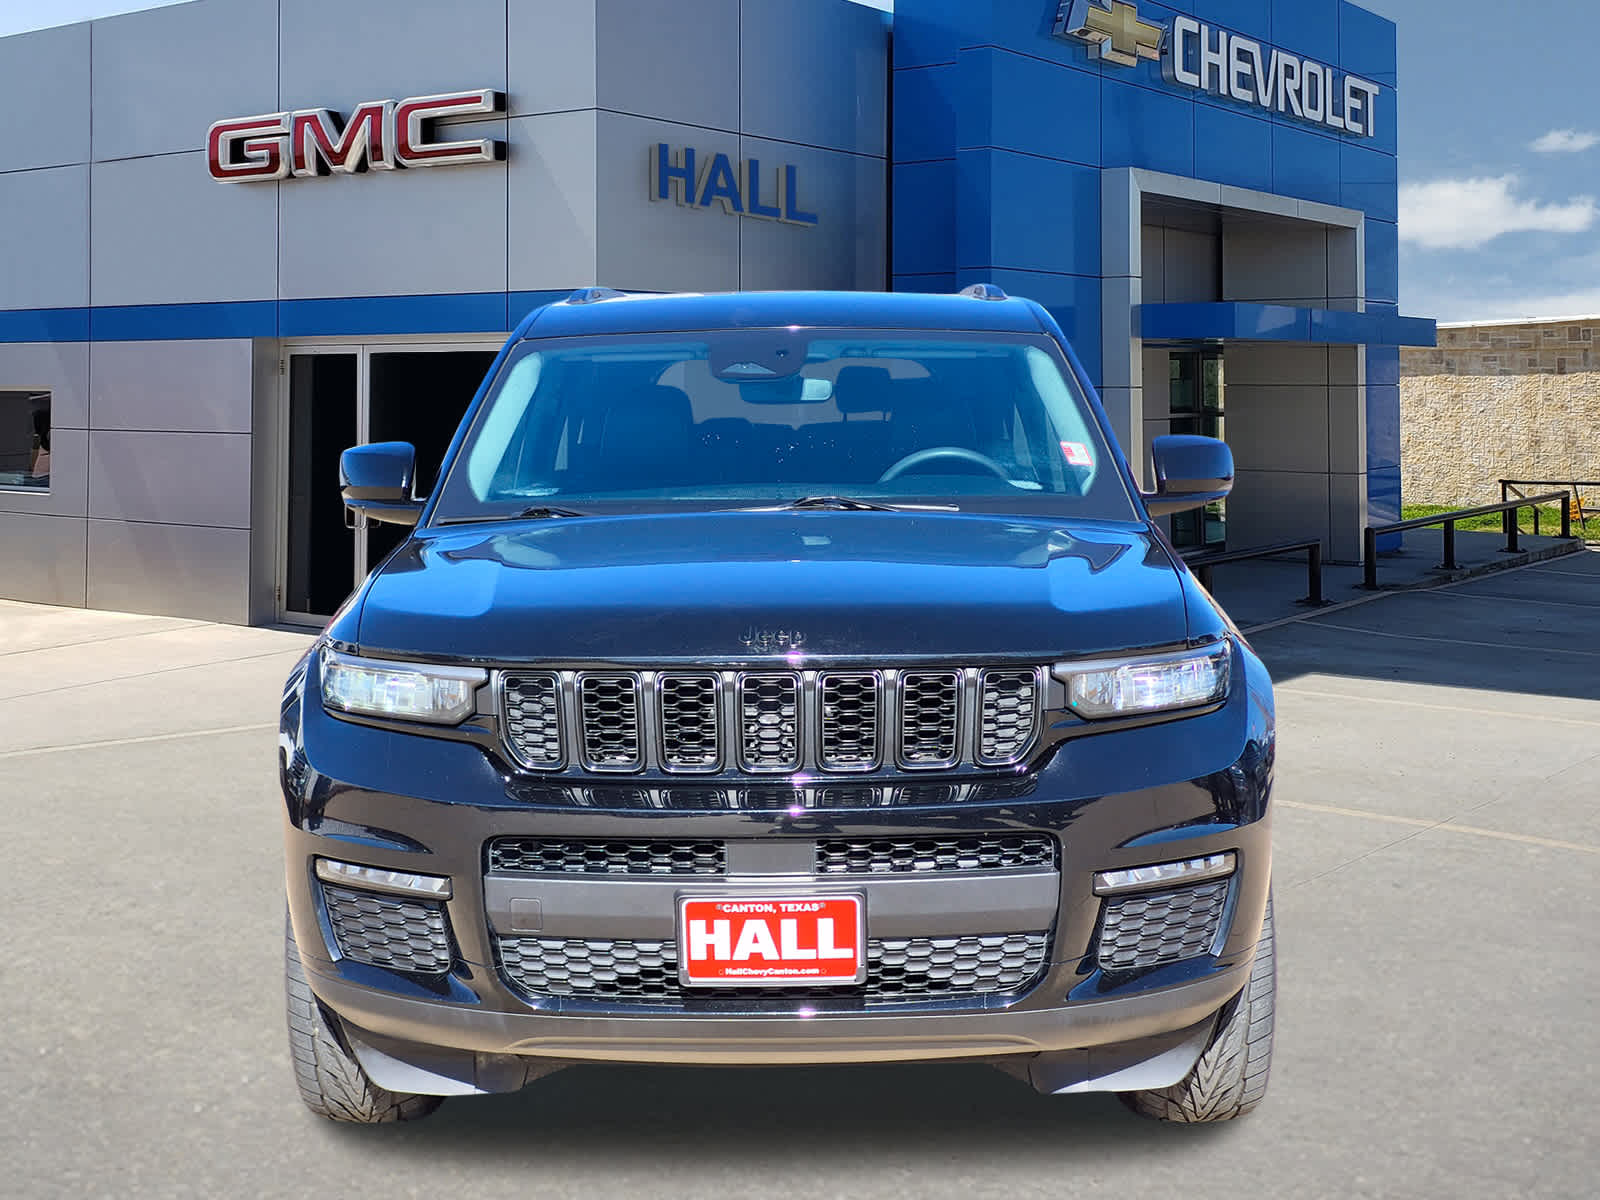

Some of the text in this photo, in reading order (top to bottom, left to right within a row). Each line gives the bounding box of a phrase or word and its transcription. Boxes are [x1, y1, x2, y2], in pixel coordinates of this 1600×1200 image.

[1172, 15, 1380, 137] CHEVROLET
[206, 87, 507, 185] GMC
[652, 142, 819, 226] HALL
[738, 624, 807, 650] Jeep
[689, 918, 854, 961] HALL
[722, 903, 820, 914] CANTON, TEXAS
